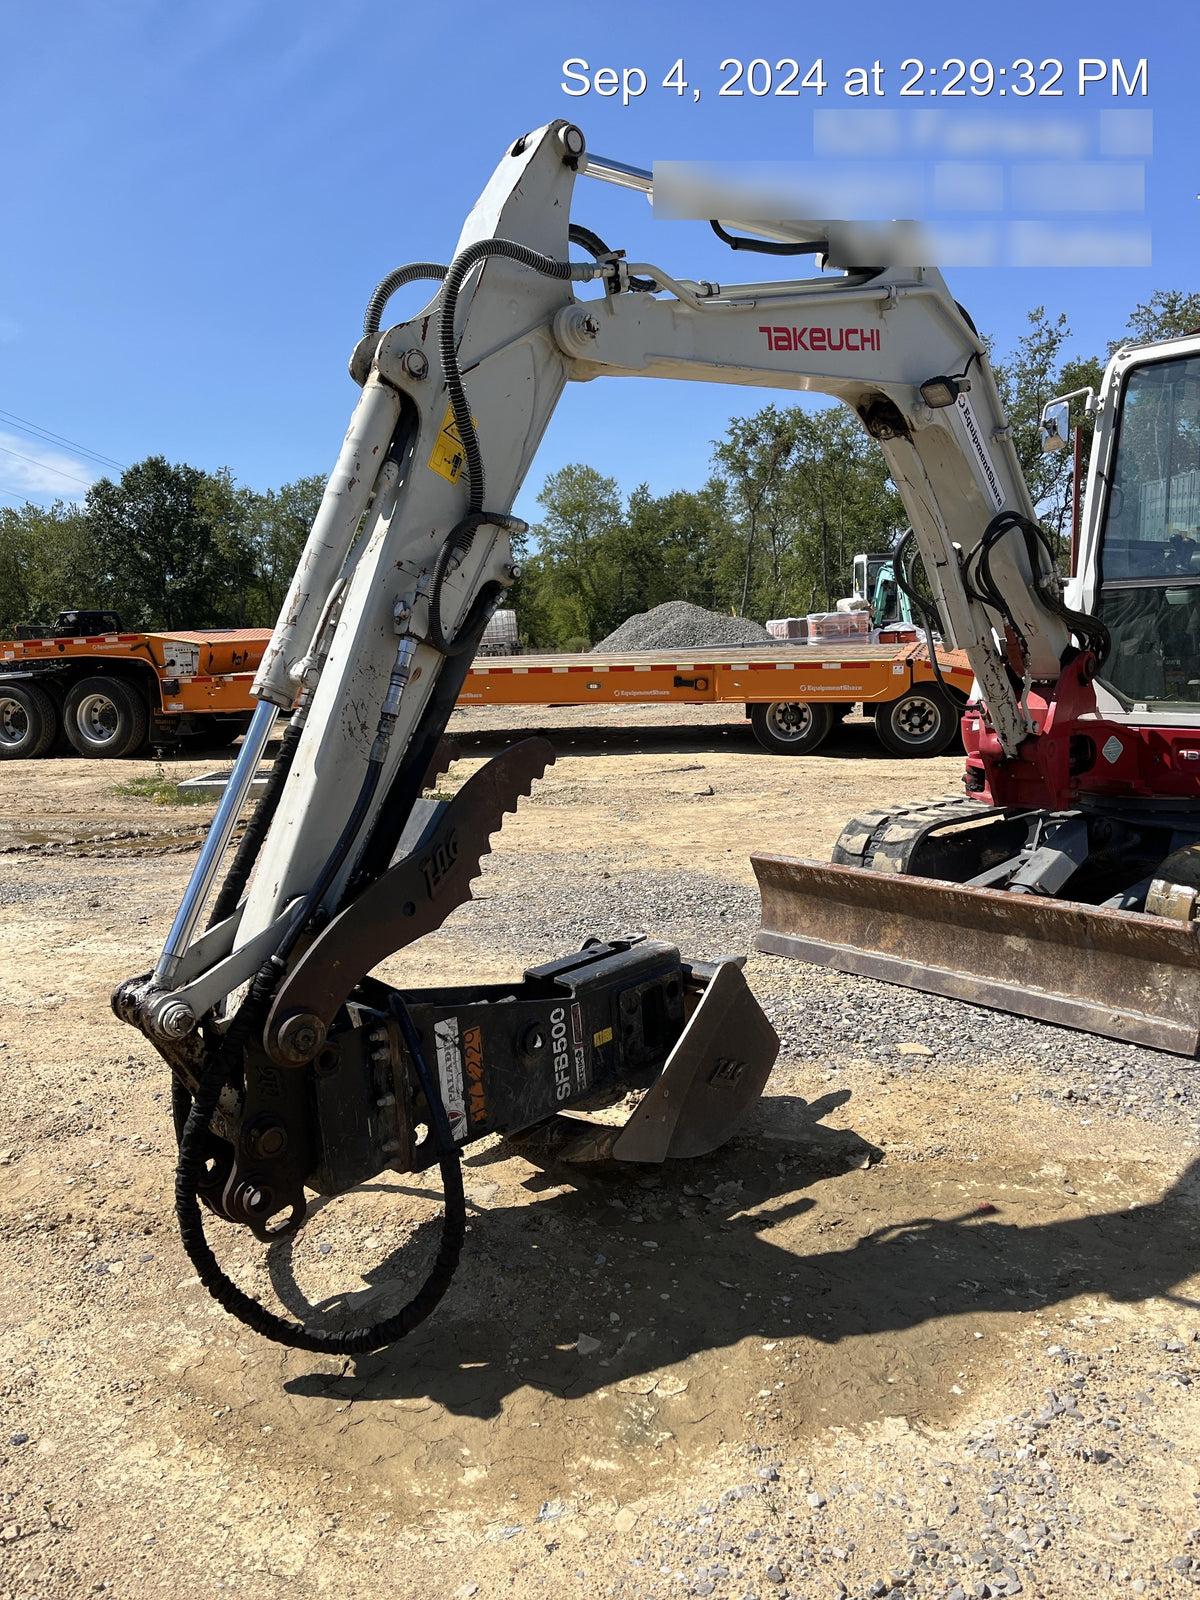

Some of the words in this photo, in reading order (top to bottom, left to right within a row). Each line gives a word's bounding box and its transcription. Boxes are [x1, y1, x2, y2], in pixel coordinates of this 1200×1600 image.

[758, 326, 881, 351] TAKEUCHI
[963, 406, 1003, 506] EquipmentShare
[621, 689, 670, 697] EquipmentShare
[807, 684, 863, 692] EquipmentShare
[549, 1007, 572, 1101] SFB500
